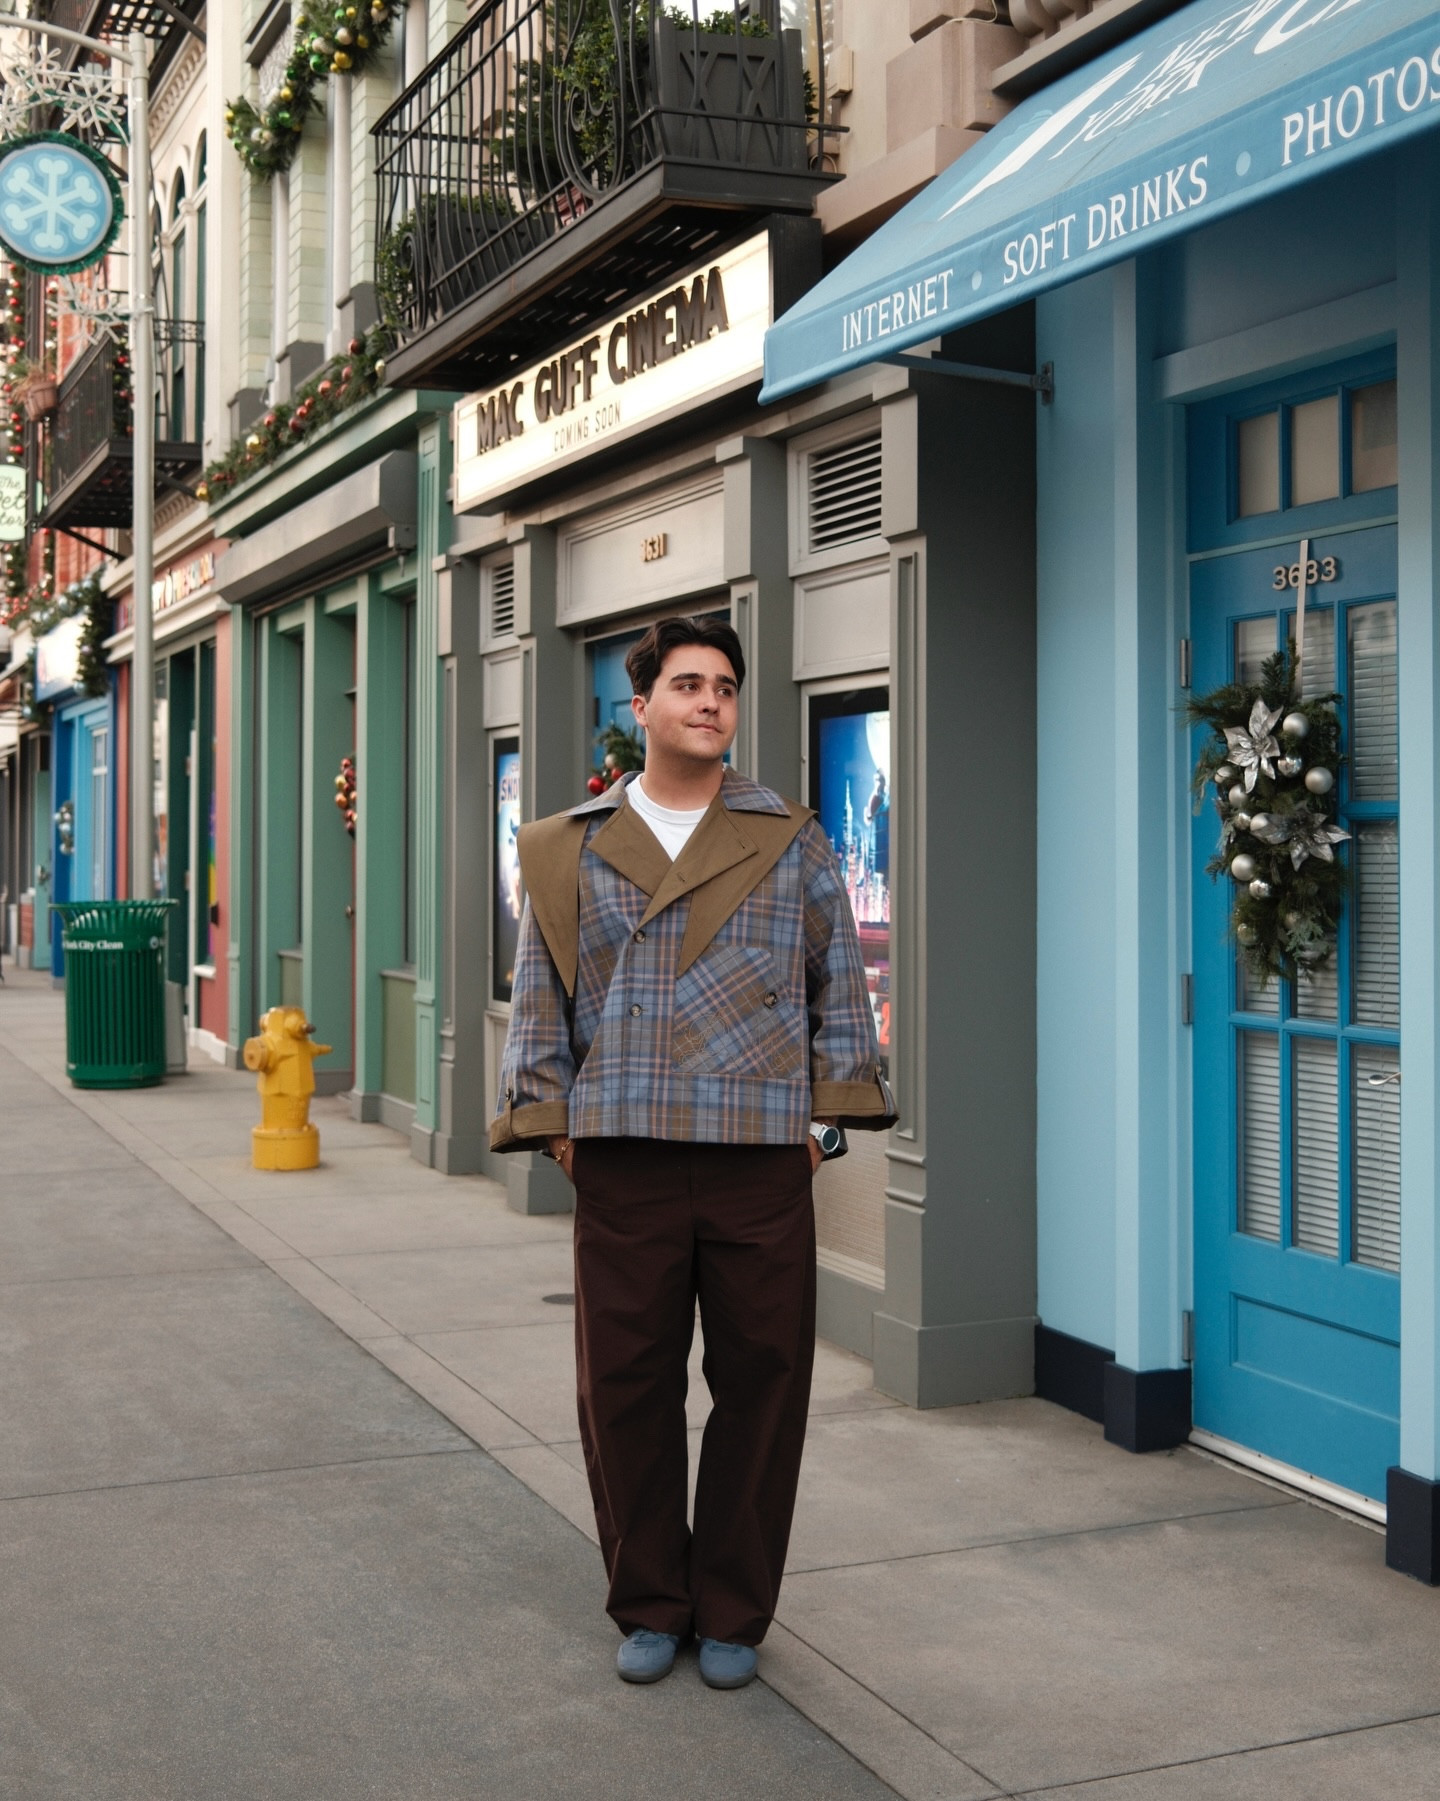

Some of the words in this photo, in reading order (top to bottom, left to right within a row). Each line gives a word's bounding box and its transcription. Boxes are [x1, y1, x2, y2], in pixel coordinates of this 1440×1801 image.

[1048, 29, 1256, 160] YORK
[1125, 0, 1280, 96] NEW
[841, 268, 954, 352] INTERNET
[1002, 213, 1077, 285] SOFT
[1085, 154, 1209, 251] DRINKS
[477, 380, 524, 456] MAC
[534, 334, 601, 424] GUFF
[607, 265, 729, 385] CINEMA
[553, 416, 589, 452] COMING
[594, 400, 622, 433] SOON
[1271, 555, 1337, 591] 3633
